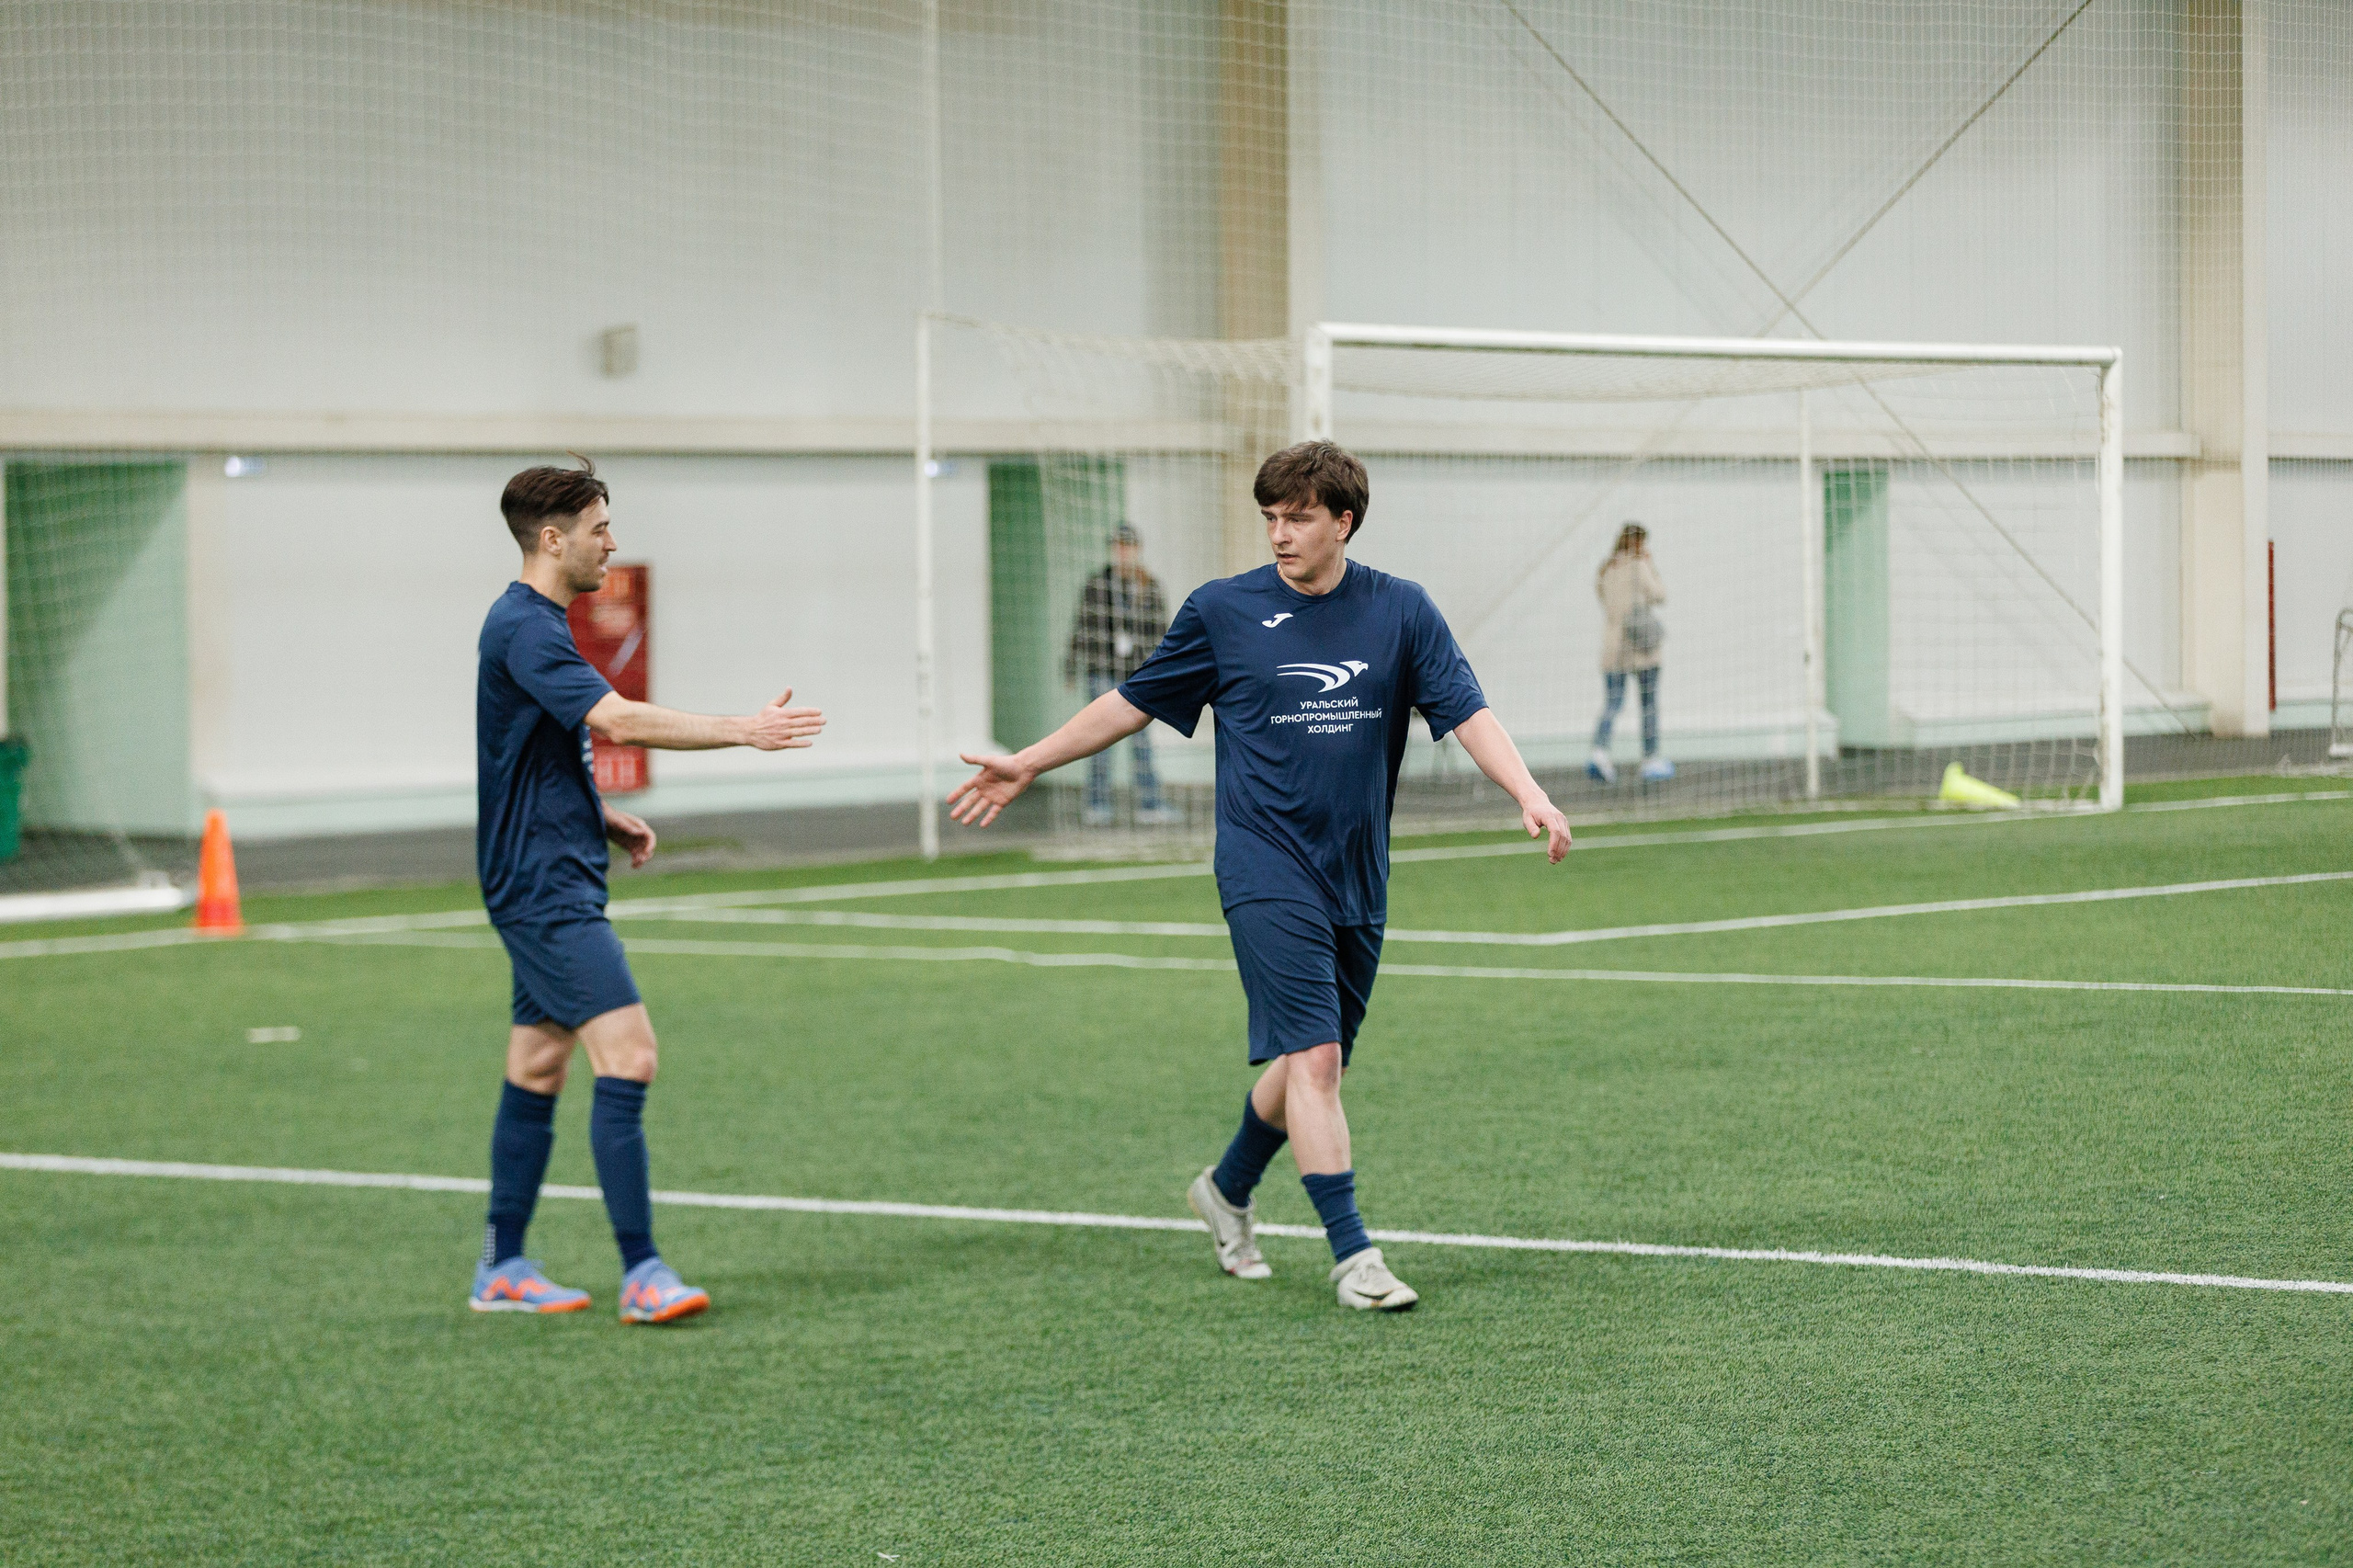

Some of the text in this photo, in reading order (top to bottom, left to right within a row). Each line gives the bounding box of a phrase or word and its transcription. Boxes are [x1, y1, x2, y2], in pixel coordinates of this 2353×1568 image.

[1300, 697, 1358, 710] УРАЛЬСКИЙ
[1270, 709, 1382, 724] ГОРНОПРОМЫШЛЕННЫЙ
[1307, 723, 1354, 734] ХОЛДИНГ
